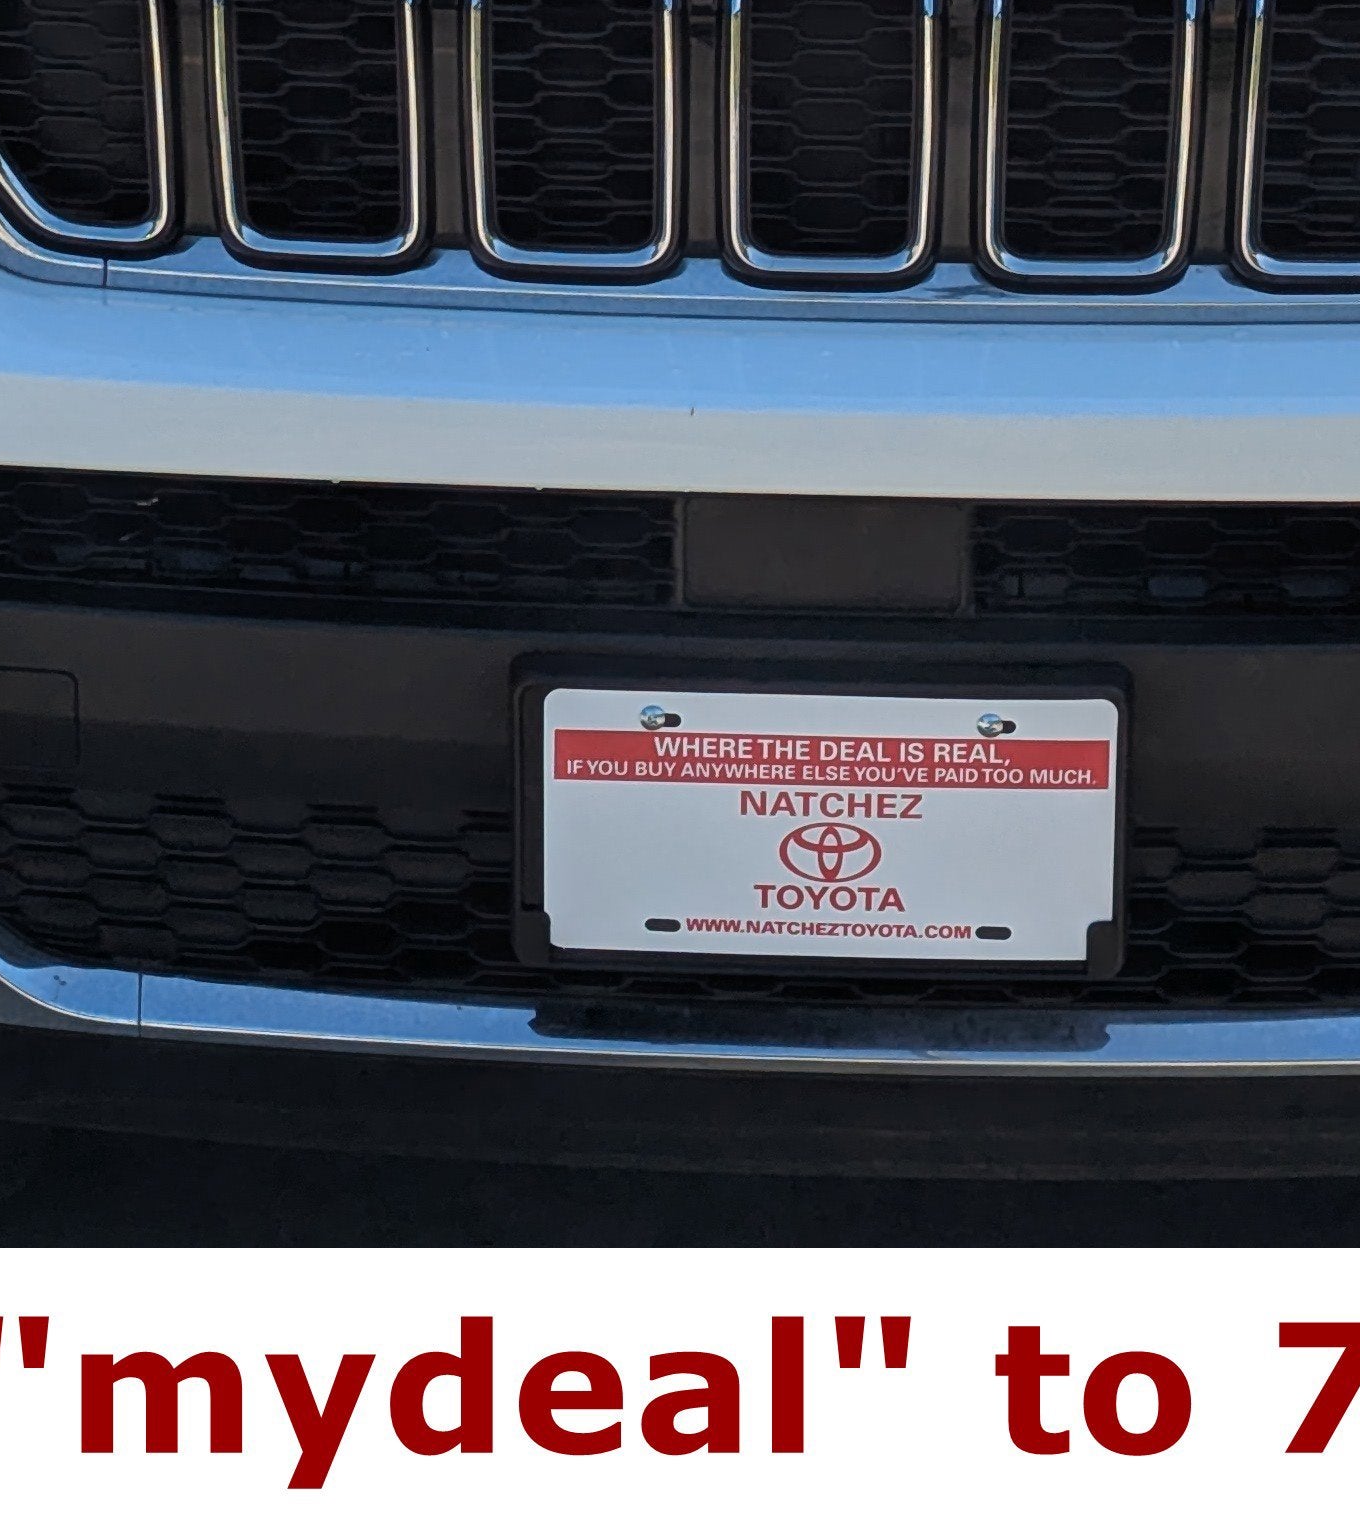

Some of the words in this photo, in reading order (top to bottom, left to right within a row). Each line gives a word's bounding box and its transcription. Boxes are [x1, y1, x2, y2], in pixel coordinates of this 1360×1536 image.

[653, 736, 753, 760] WHERE
[757, 739, 811, 761] THE
[820, 740, 891, 763] DEAL
[899, 742, 925, 764] IS
[933, 743, 1011, 767] REAL,
[566, 759, 584, 775] IF
[586, 760, 628, 776] YOU
[635, 761, 677, 777] BUY
[680, 762, 796, 780] ANYWHERE
[802, 764, 851, 781] ELSE
[854, 766, 929, 783] YOU'VE
[934, 767, 978, 783] PAID
[981, 768, 1024, 784] TOO
[1029, 768, 1097, 785] MUCH.
[739, 790, 923, 819] NATCHEZ
[753, 884, 906, 912] TOYOTA
[685, 917, 972, 939] WWW.NATCHEZTOYOTA.COM
